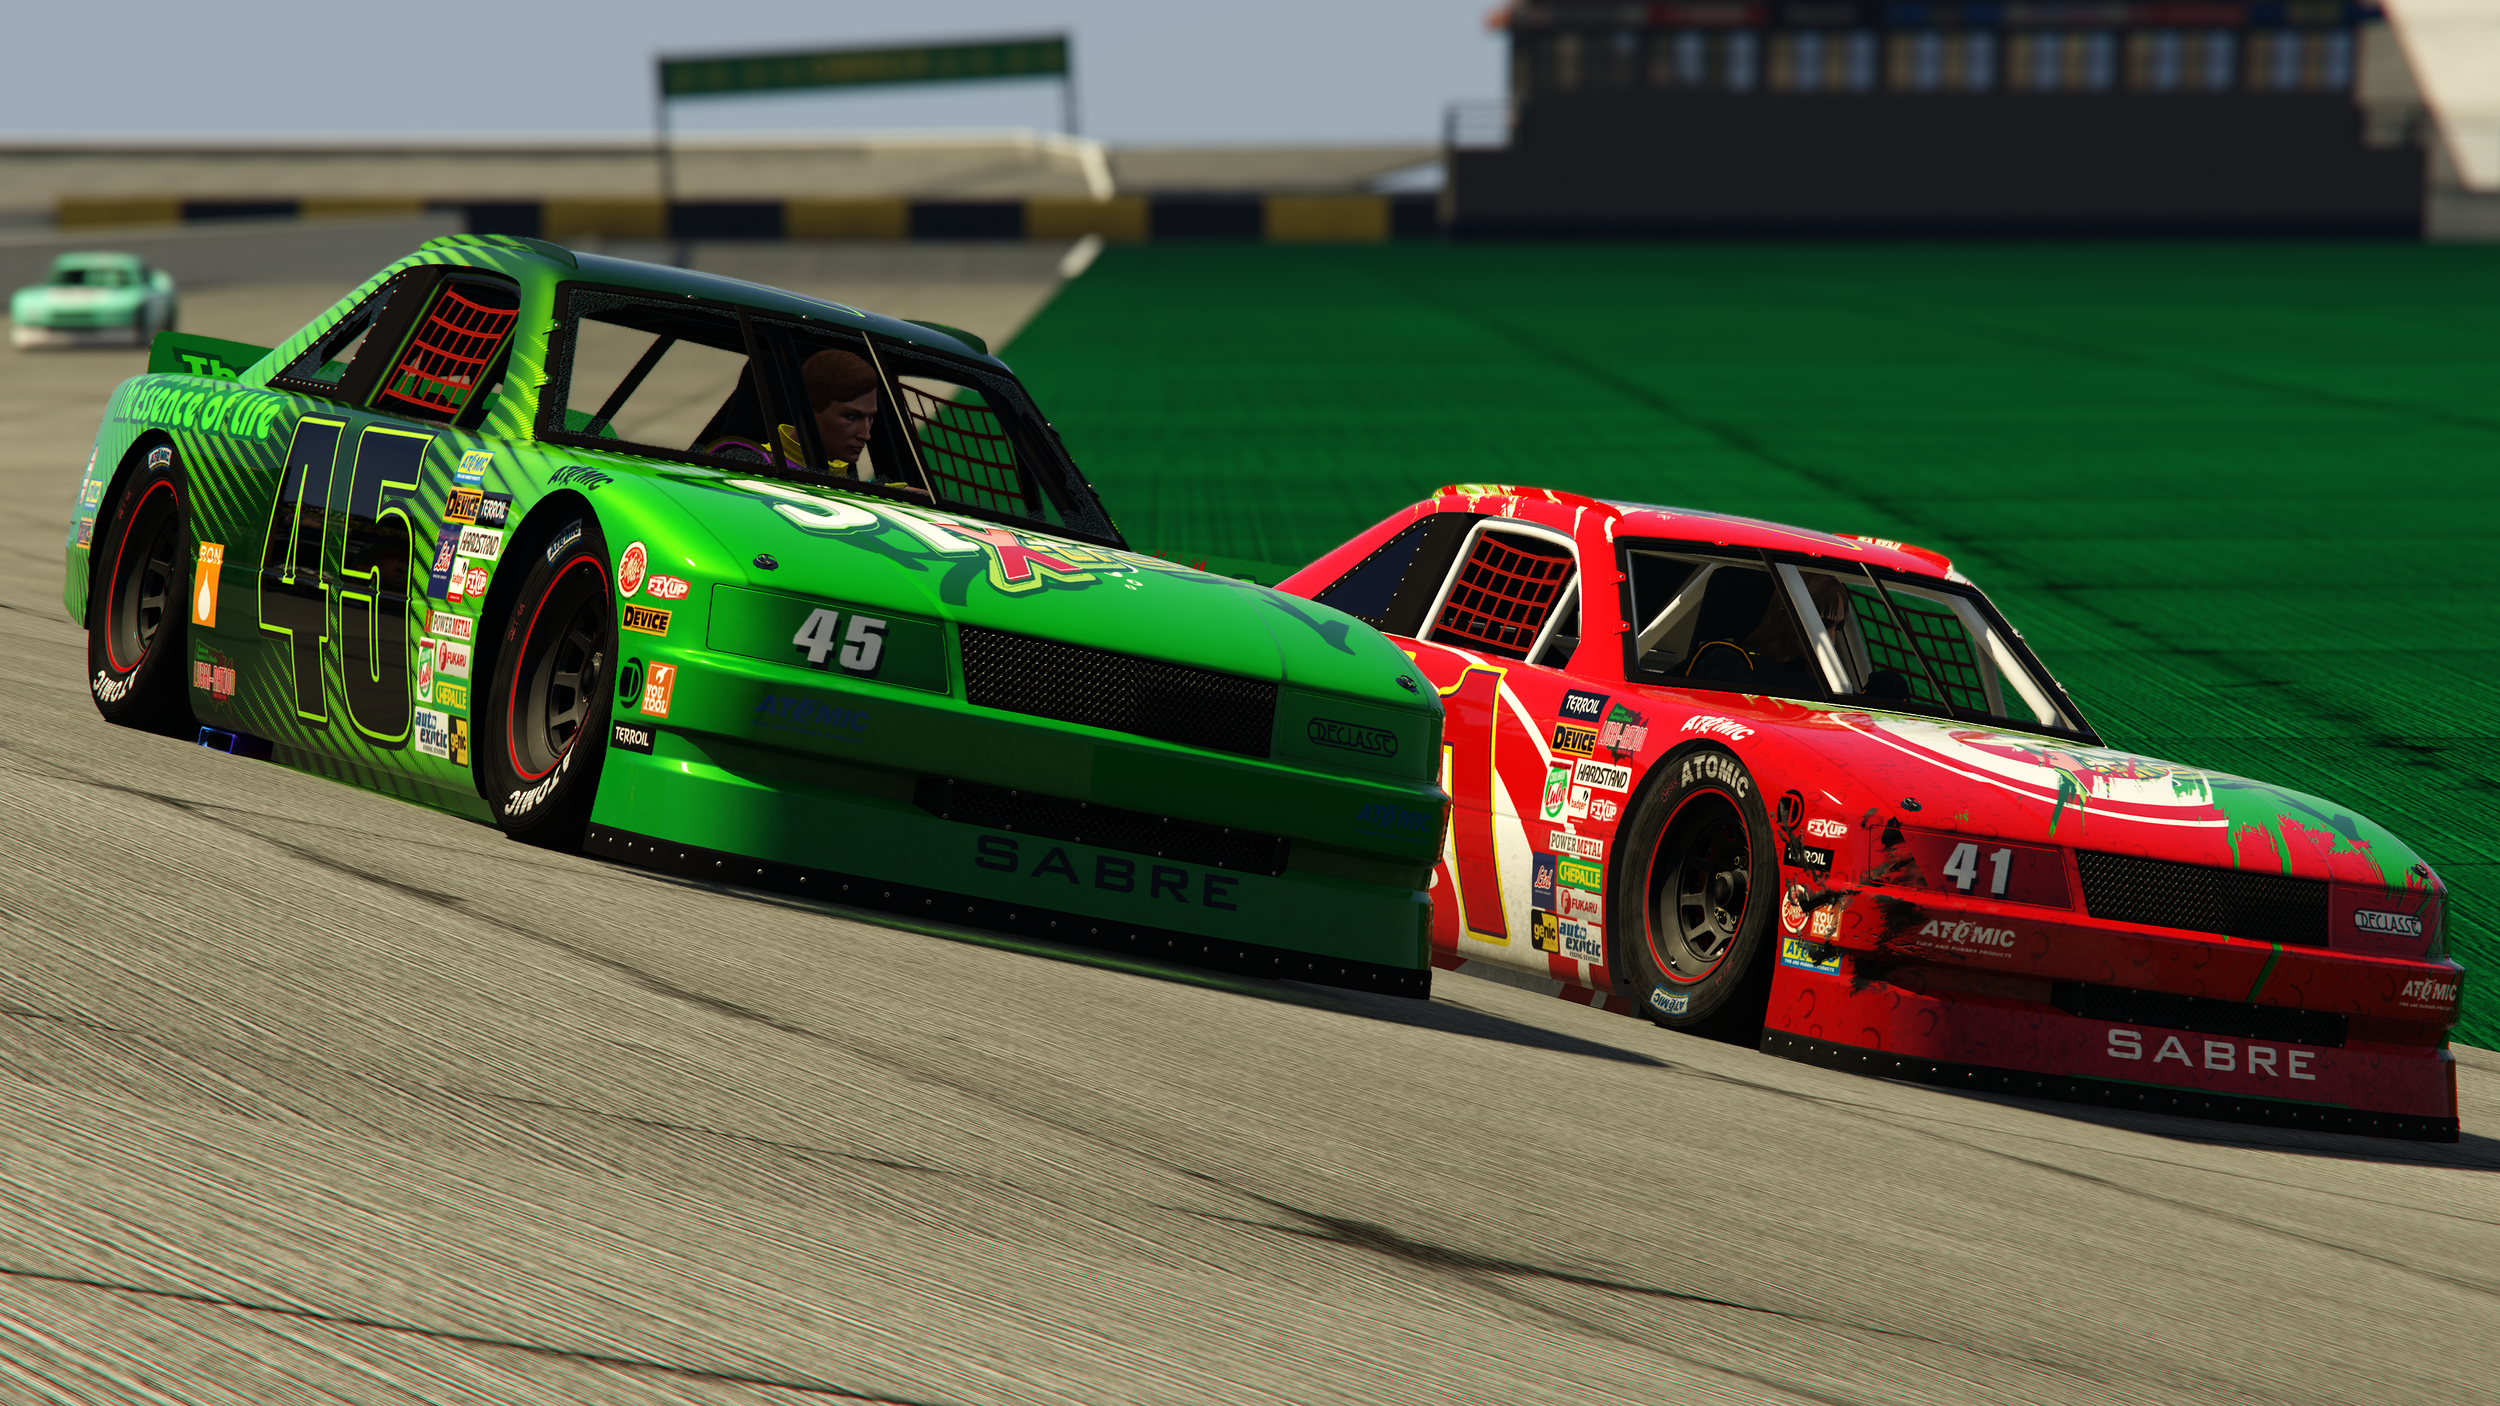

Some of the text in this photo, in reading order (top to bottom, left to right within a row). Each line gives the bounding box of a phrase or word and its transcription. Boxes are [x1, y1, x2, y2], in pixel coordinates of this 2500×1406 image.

[180, 353, 240, 378] Th
[132, 380, 205, 429] Essence
[230, 391, 281, 440] Life
[445, 489, 482, 518] DEVICE
[481, 499, 507, 520] TERROIL
[200, 545, 223, 566] RON
[459, 531, 500, 556] HARDSTAND
[258, 415, 435, 744] 45
[648, 574, 689, 598] FIXUP
[623, 605, 669, 631] DEVICE
[792, 608, 887, 671] 45
[447, 651, 467, 668] FUKARU
[436, 680, 467, 710] CHEPALLE
[646, 683, 664, 699] YOU
[642, 696, 667, 715] TOOL
[754, 694, 870, 733] ATOMIC
[1566, 694, 1601, 715] TERROIL
[615, 725, 650, 747] TERROIL
[1308, 718, 1398, 757] DECLASSE
[1552, 725, 1596, 752] DEVICE
[1680, 715, 1755, 741] ATOMIC
[1576, 762, 1628, 789] HARDSTAND
[1681, 754, 1749, 798] ATOMIC
[1590, 799, 1617, 822] FIXUP
[1807, 818, 1848, 838] FIXUP
[974, 834, 1240, 912] SABRE
[1534, 864, 1553, 889] Ltd
[1559, 860, 1601, 889] CHEPALLE
[1942, 842, 2012, 895] 41
[1571, 898, 1598, 914] FUKARU
[1814, 910, 1834, 925] YOU
[1534, 922, 1556, 941] genic
[1559, 921, 1587, 940] auto
[1919, 919, 2016, 948] ATOMIC
[2354, 909, 2422, 937] DECLASSE
[1979, 950, 2012, 959] PRODUCTS
[1653, 992, 1686, 1013] ATOMIC
[2401, 978, 2458, 1002] ATOMIC
[2107, 1028, 2316, 1081] SABRE
